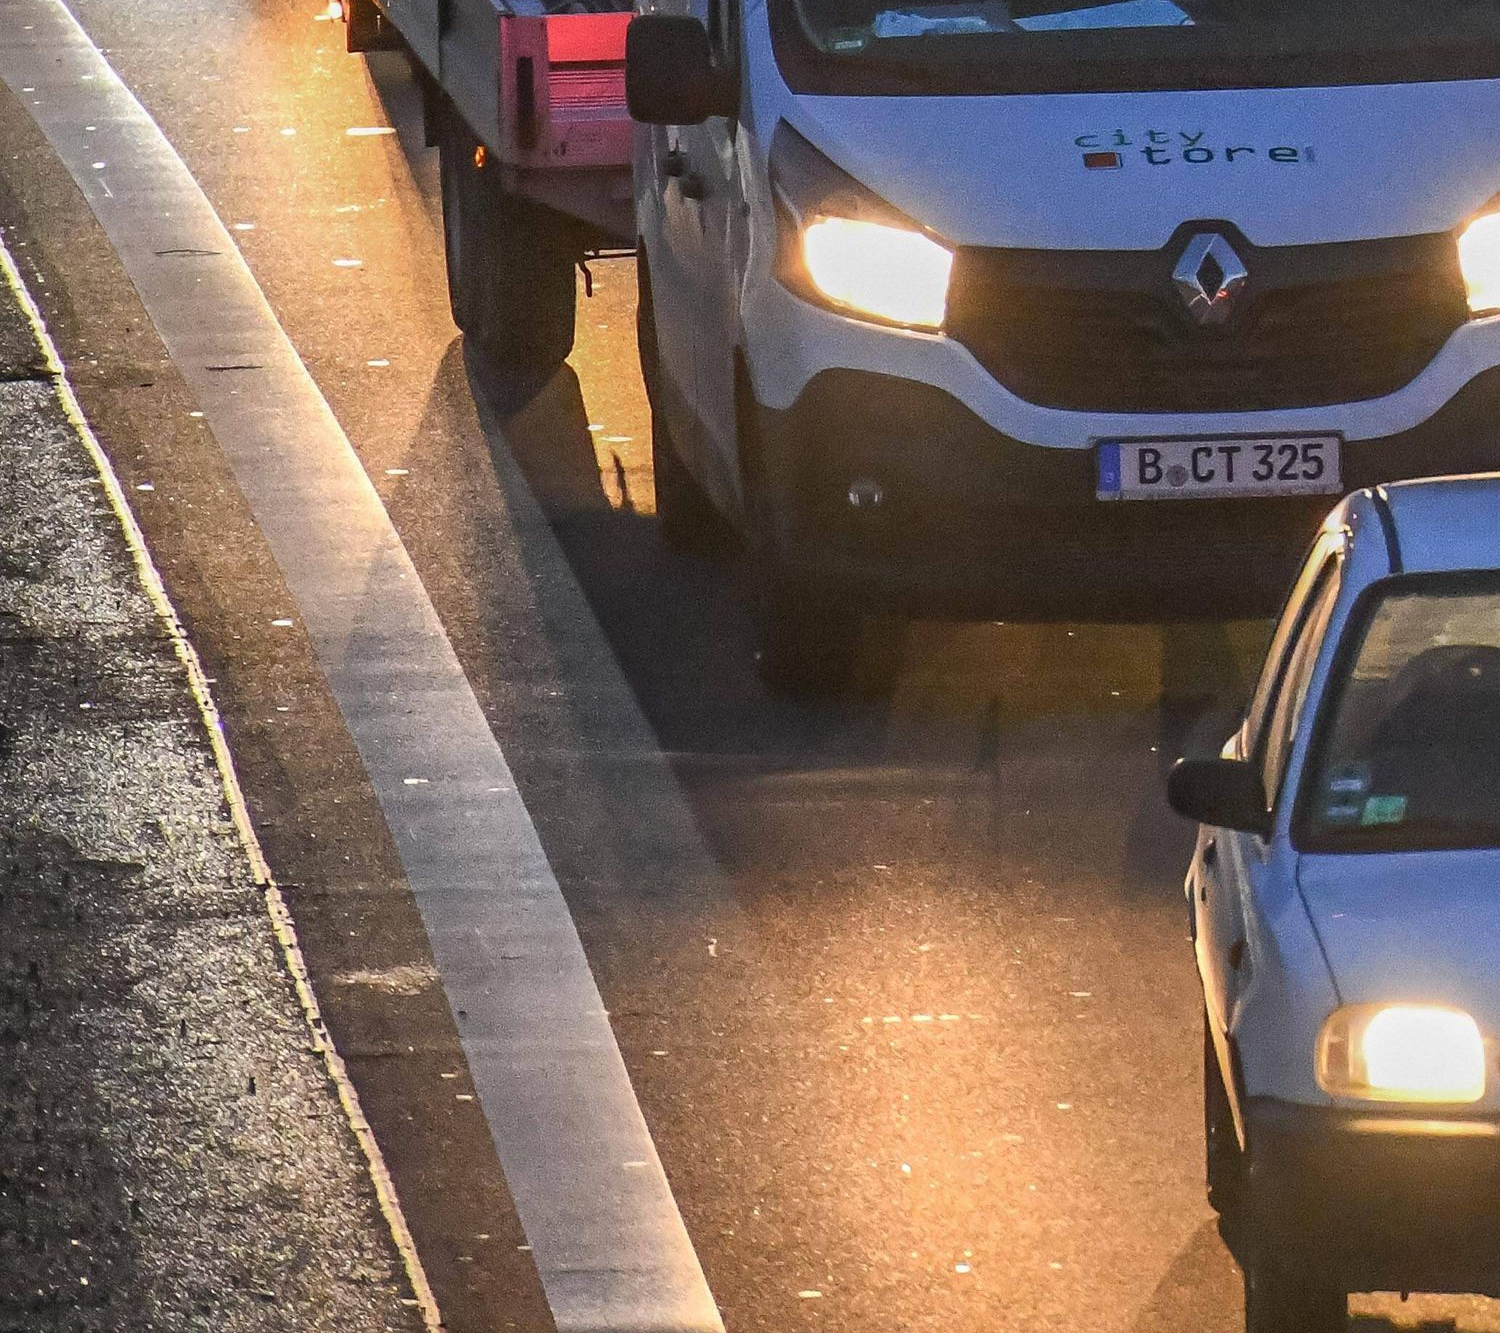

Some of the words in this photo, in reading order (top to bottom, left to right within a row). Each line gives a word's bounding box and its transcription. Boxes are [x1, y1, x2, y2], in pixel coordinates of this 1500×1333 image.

[1074, 129, 1205, 147] city
[1138, 448, 1163, 485] B
[1191, 445, 1242, 483] CT
[1252, 442, 1325, 481] 325
